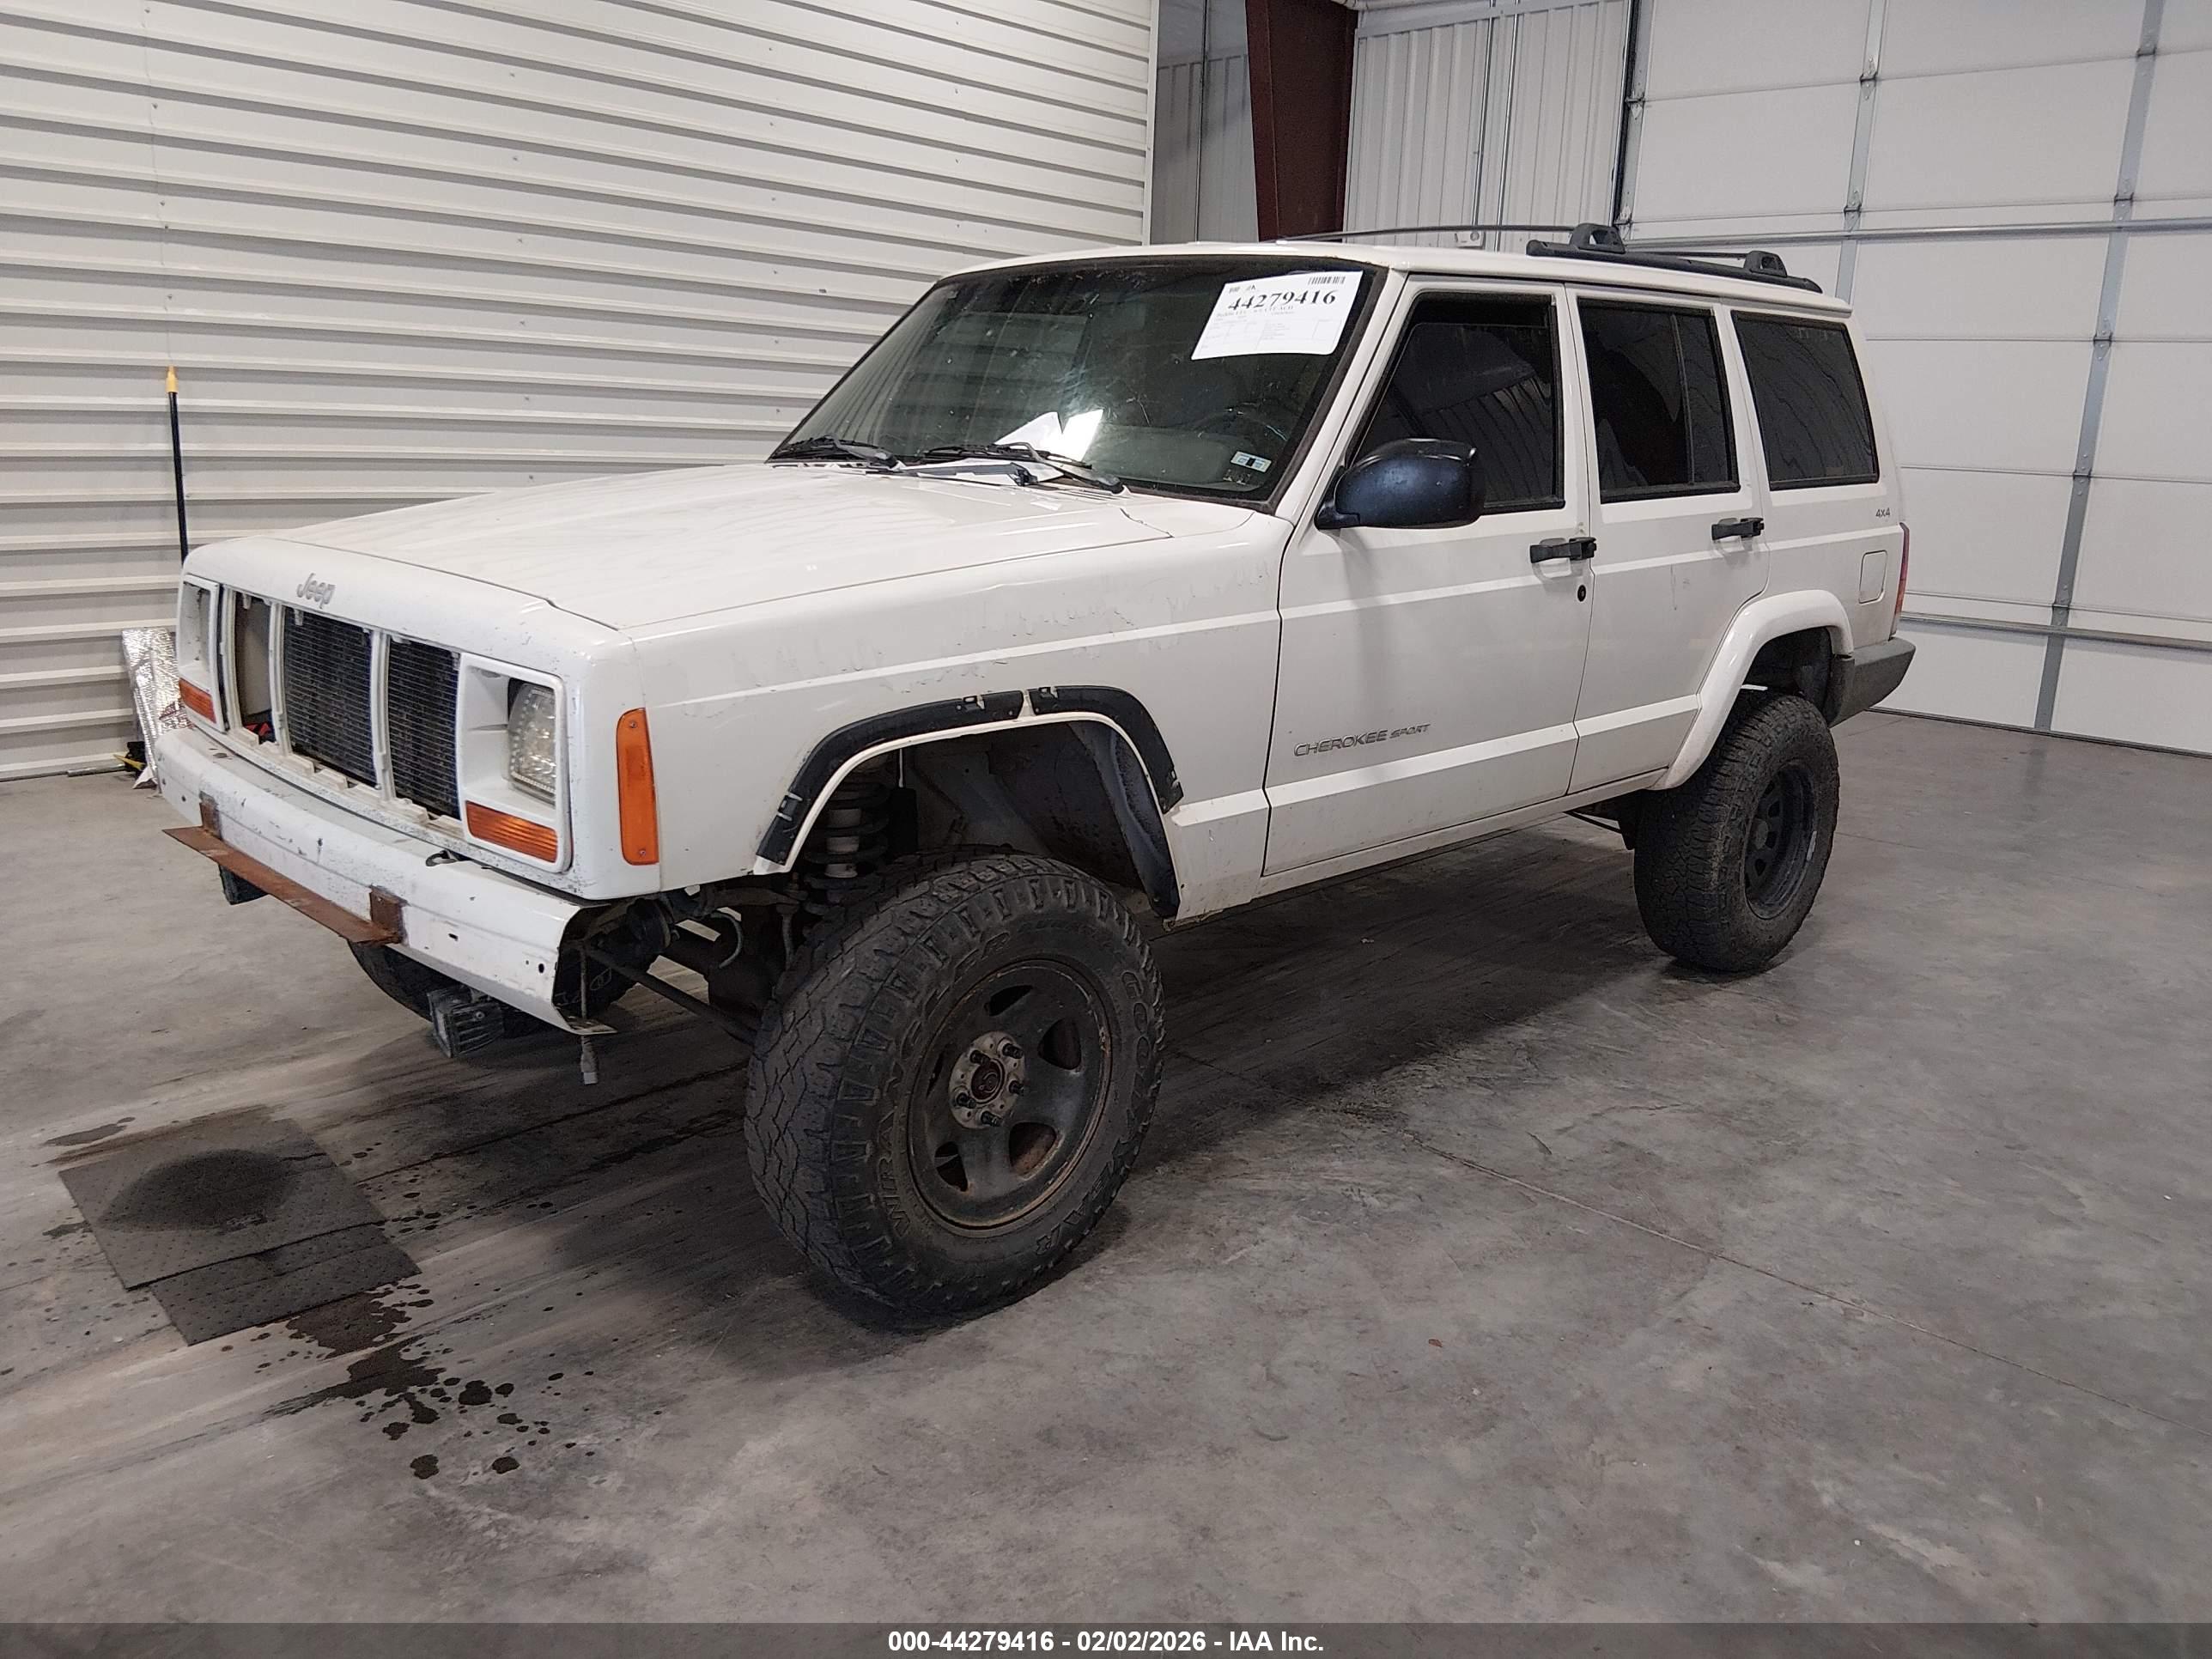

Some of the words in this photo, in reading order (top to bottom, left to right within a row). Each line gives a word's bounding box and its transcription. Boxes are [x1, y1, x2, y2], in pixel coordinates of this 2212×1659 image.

[1228, 289, 1339, 311] 44279416
[296, 573, 336, 609] Jeep
[1293, 730, 1388, 757] CHEROKEE
[1389, 724, 1431, 738] SPORT
